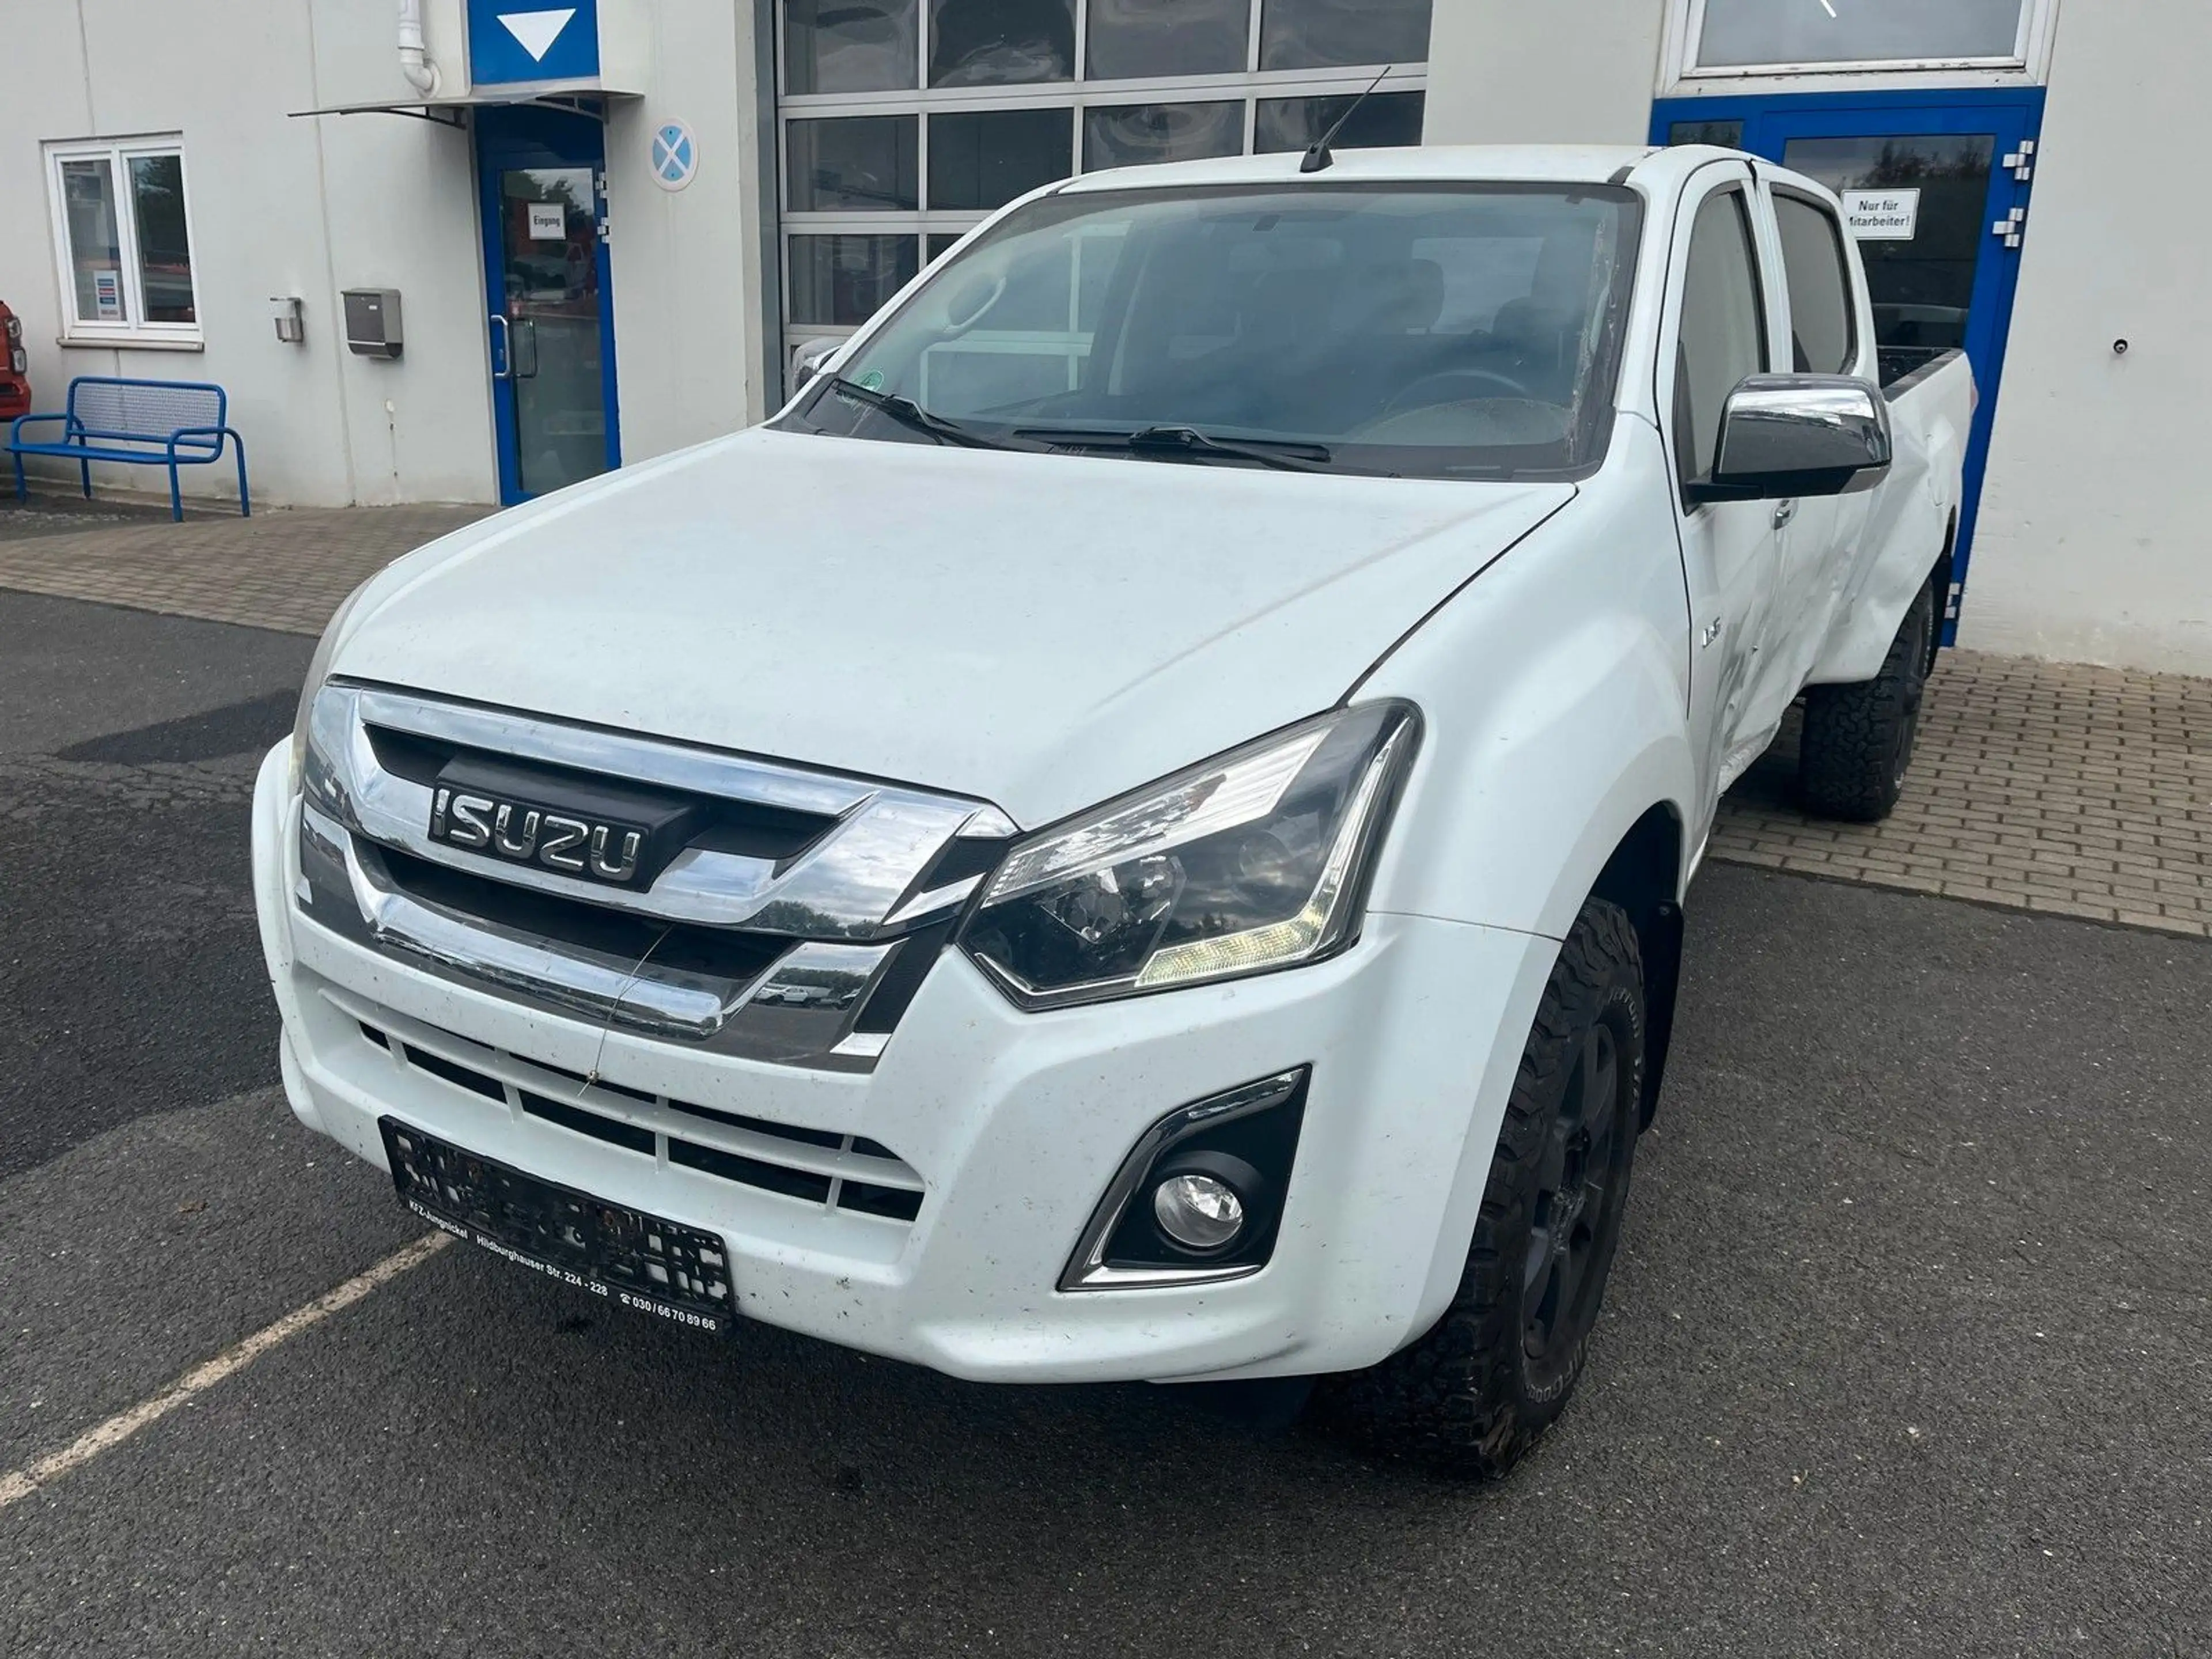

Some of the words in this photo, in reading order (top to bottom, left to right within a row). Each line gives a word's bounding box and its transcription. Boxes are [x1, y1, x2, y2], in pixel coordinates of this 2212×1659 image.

[533, 215, 560, 228] Eingang
[1858, 200, 1880, 211] Nur
[1882, 200, 1899, 211] für
[433, 788, 641, 881] ISUZU
[476, 1234, 545, 1271] Hildburghauser
[546, 1264, 562, 1279] Str.
[565, 1271, 582, 1287] 224
[632, 1297, 652, 1312] 030
[657, 1305, 671, 1318] 66
[672, 1309, 685, 1322] 70
[687, 1313, 700, 1327] 89
[702, 1317, 716, 1331] 66
